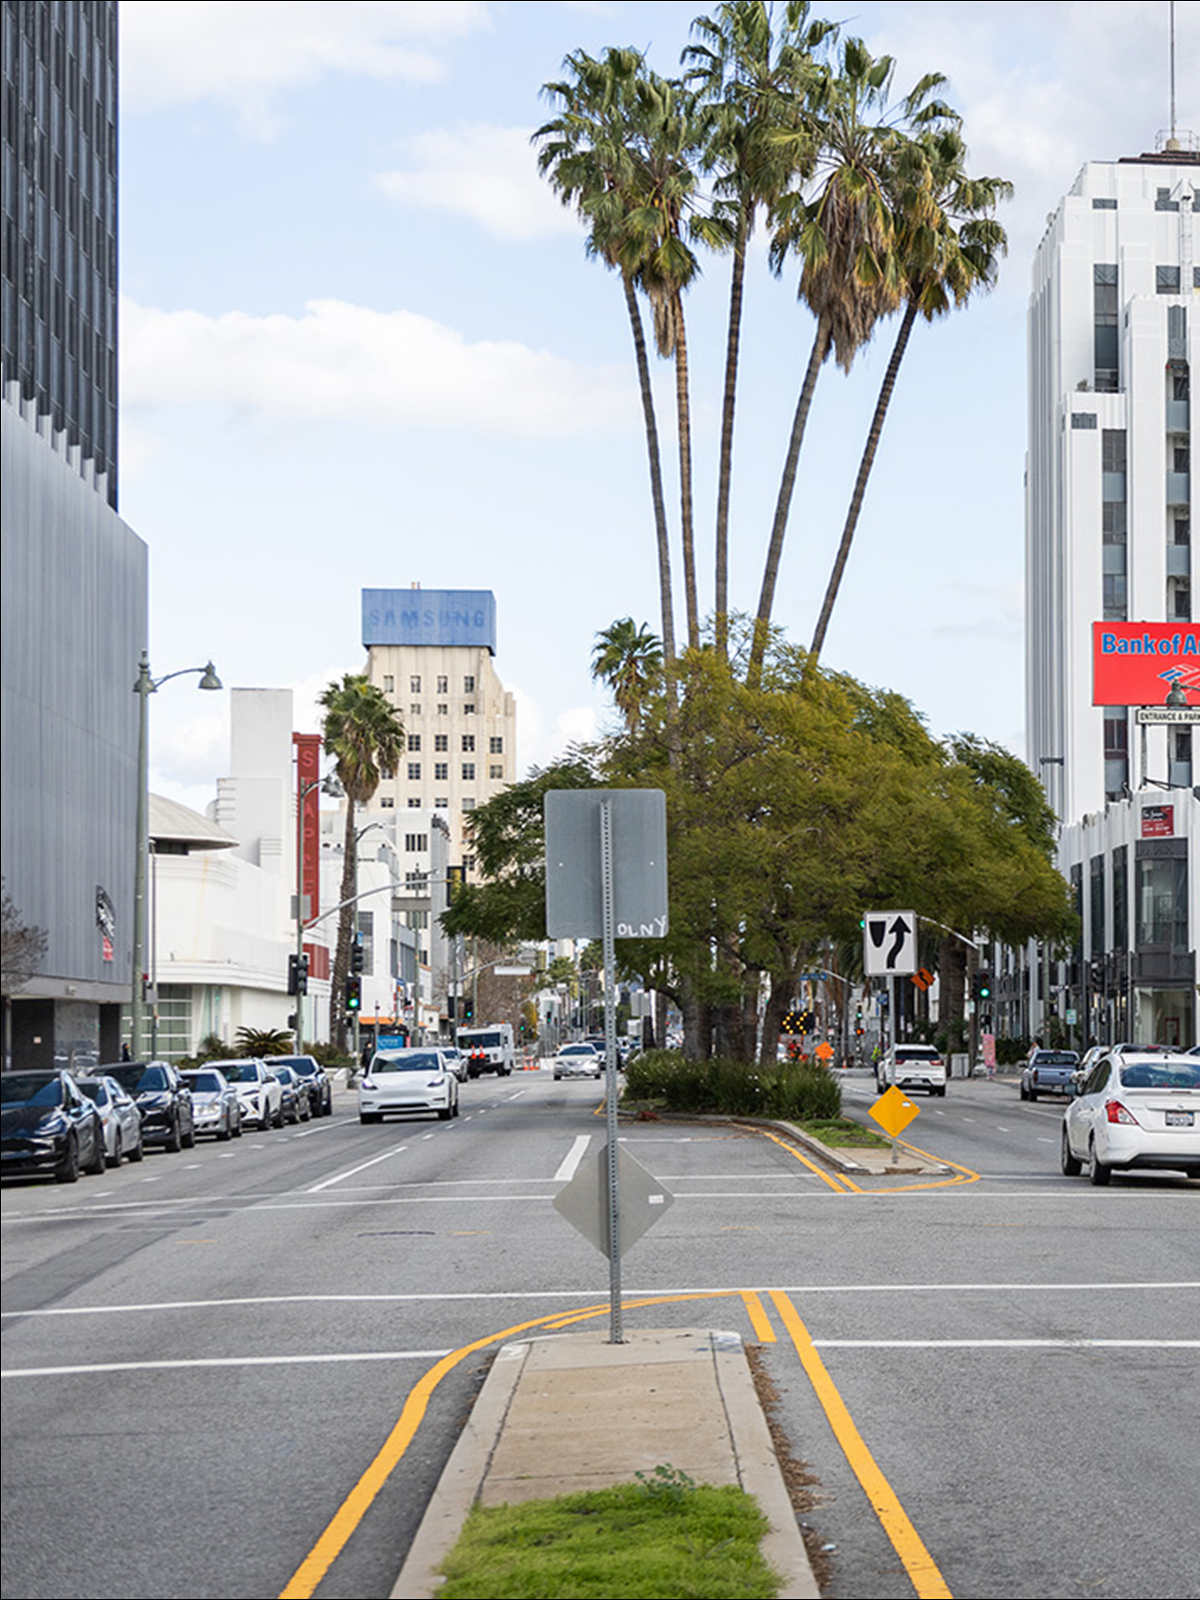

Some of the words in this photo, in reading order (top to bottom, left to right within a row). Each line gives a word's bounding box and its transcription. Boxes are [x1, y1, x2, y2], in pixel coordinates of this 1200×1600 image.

[369, 609, 485, 628] SAMSUNG
[1102, 633, 1156, 655] Bank
[1158, 633, 1181, 655] of
[1140, 712, 1176, 721] ENTRANCE
